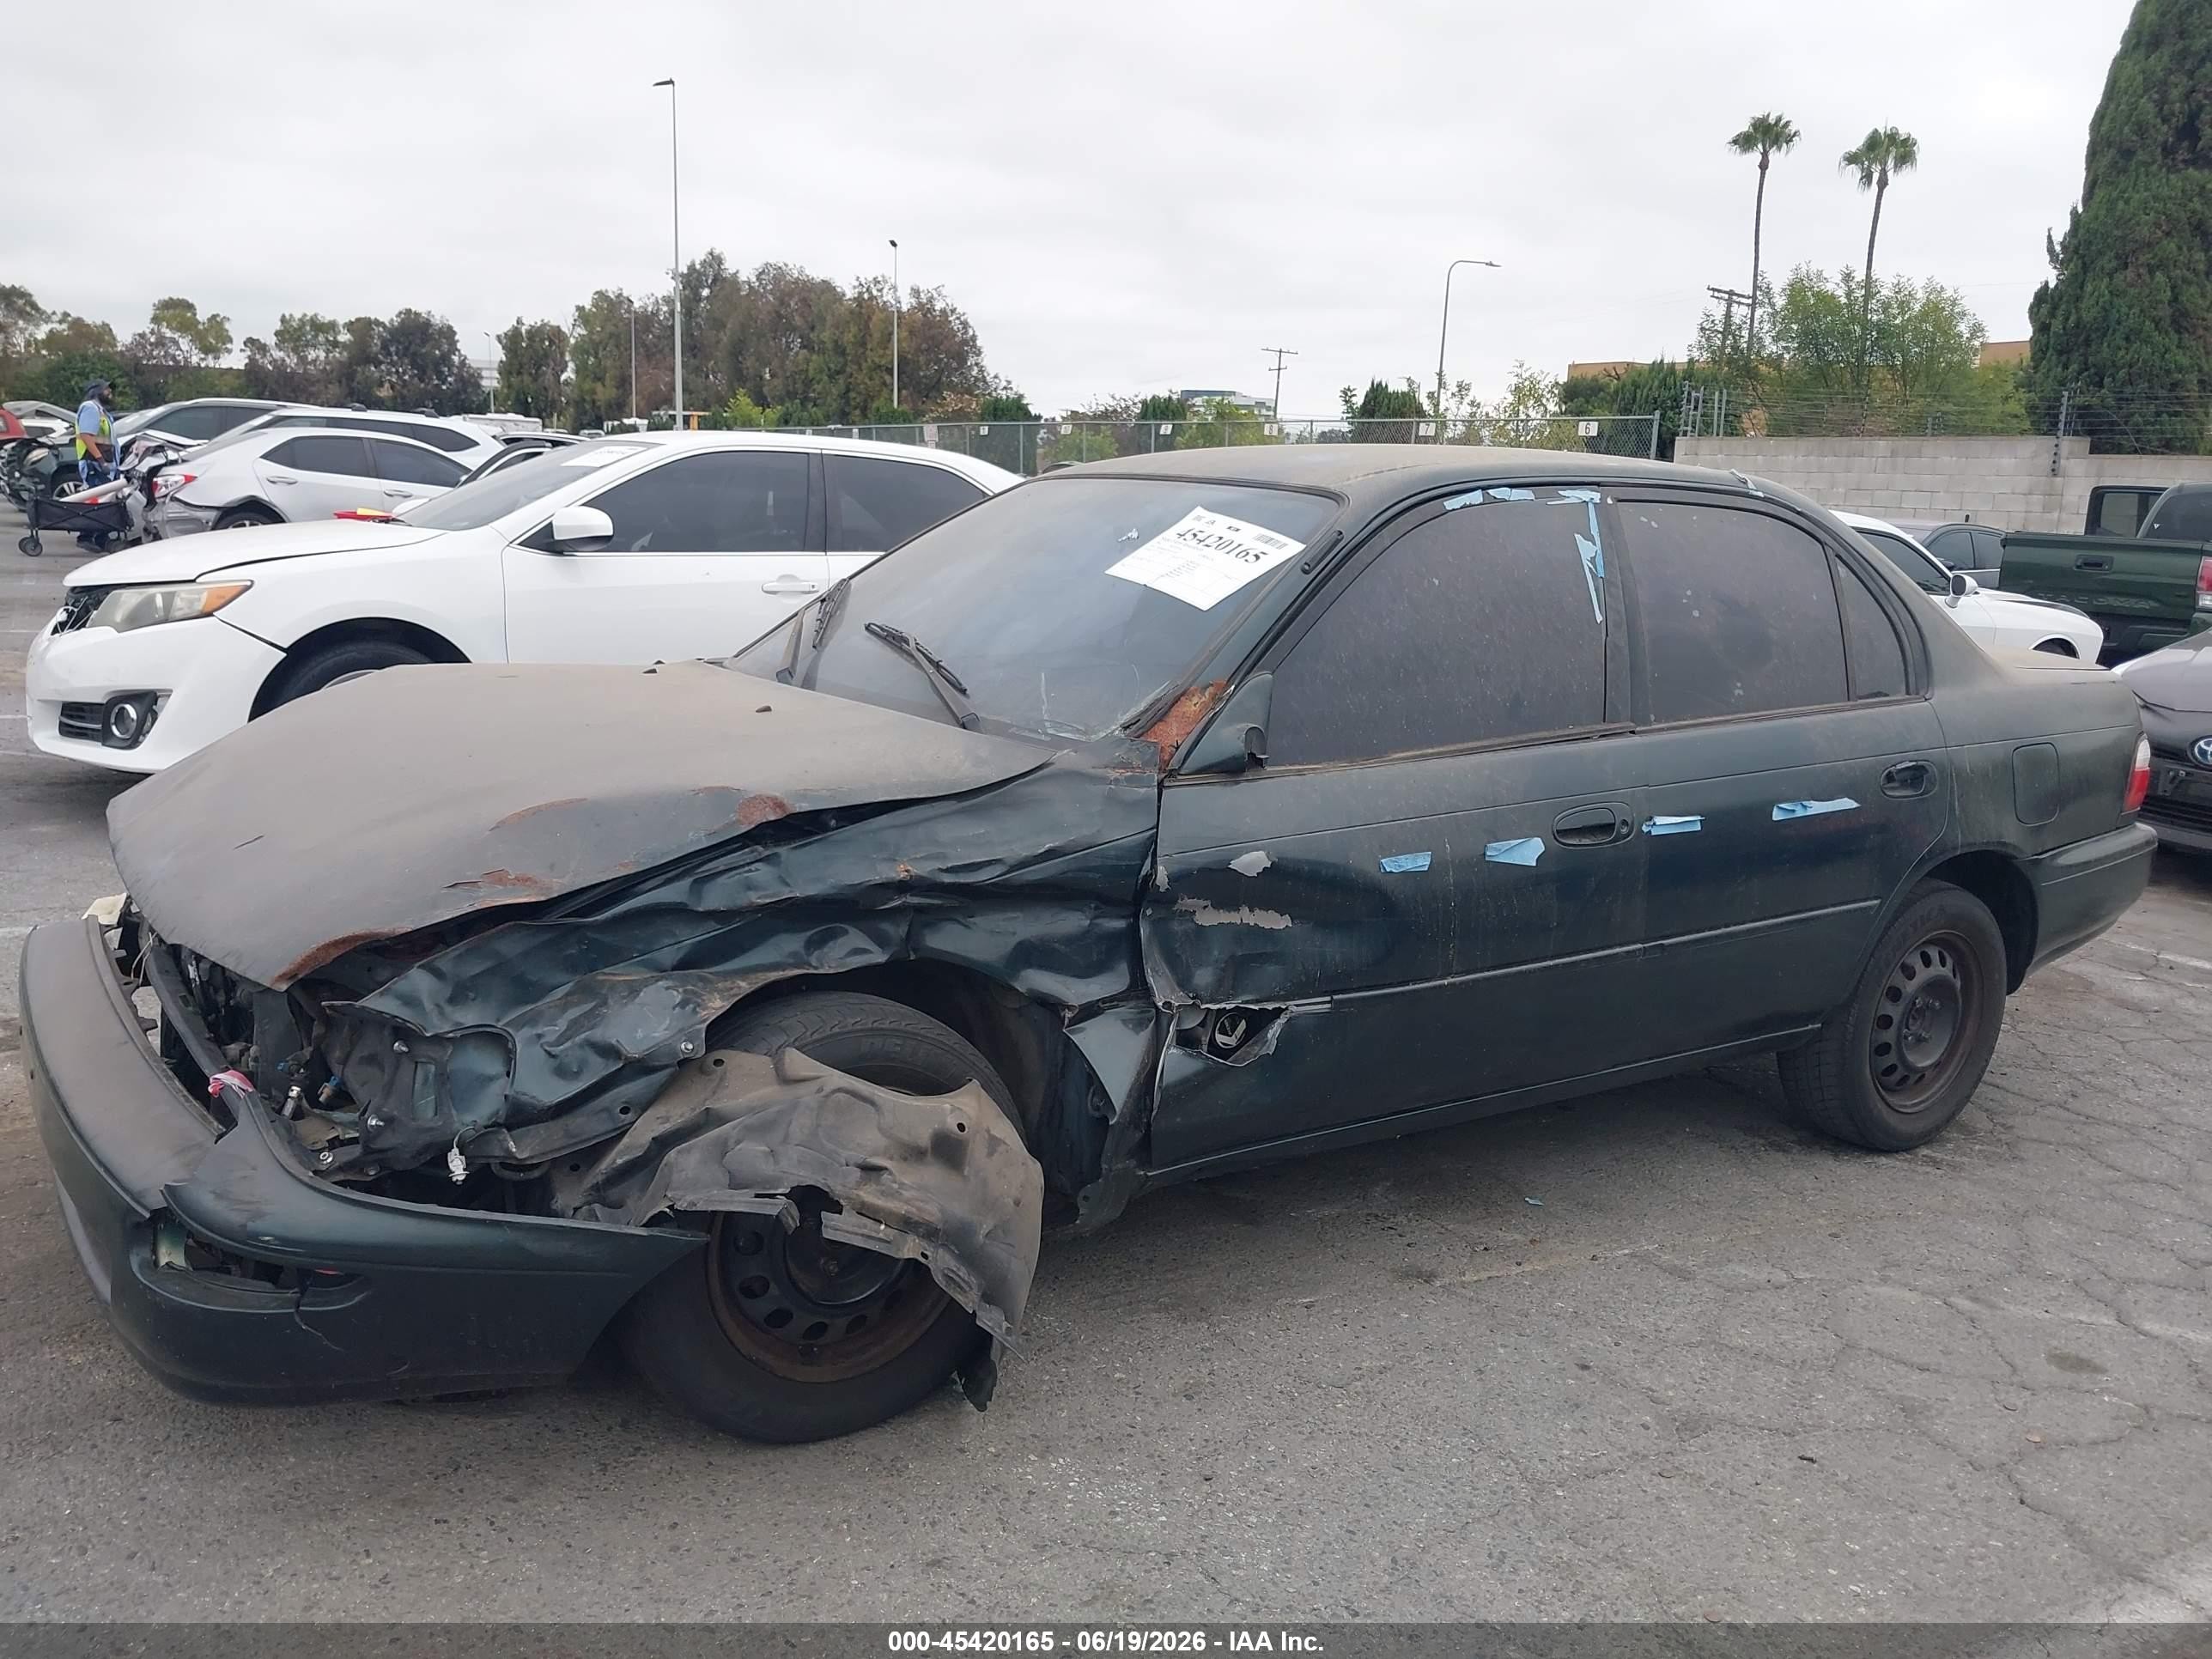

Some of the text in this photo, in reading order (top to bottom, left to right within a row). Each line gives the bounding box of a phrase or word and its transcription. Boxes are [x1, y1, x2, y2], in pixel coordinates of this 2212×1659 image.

[1268, 424, 1273, 434] 8
[1425, 423, 1430, 434] 7
[1584, 422, 1591, 434] 6
[1176, 527, 1269, 564] 45420165
